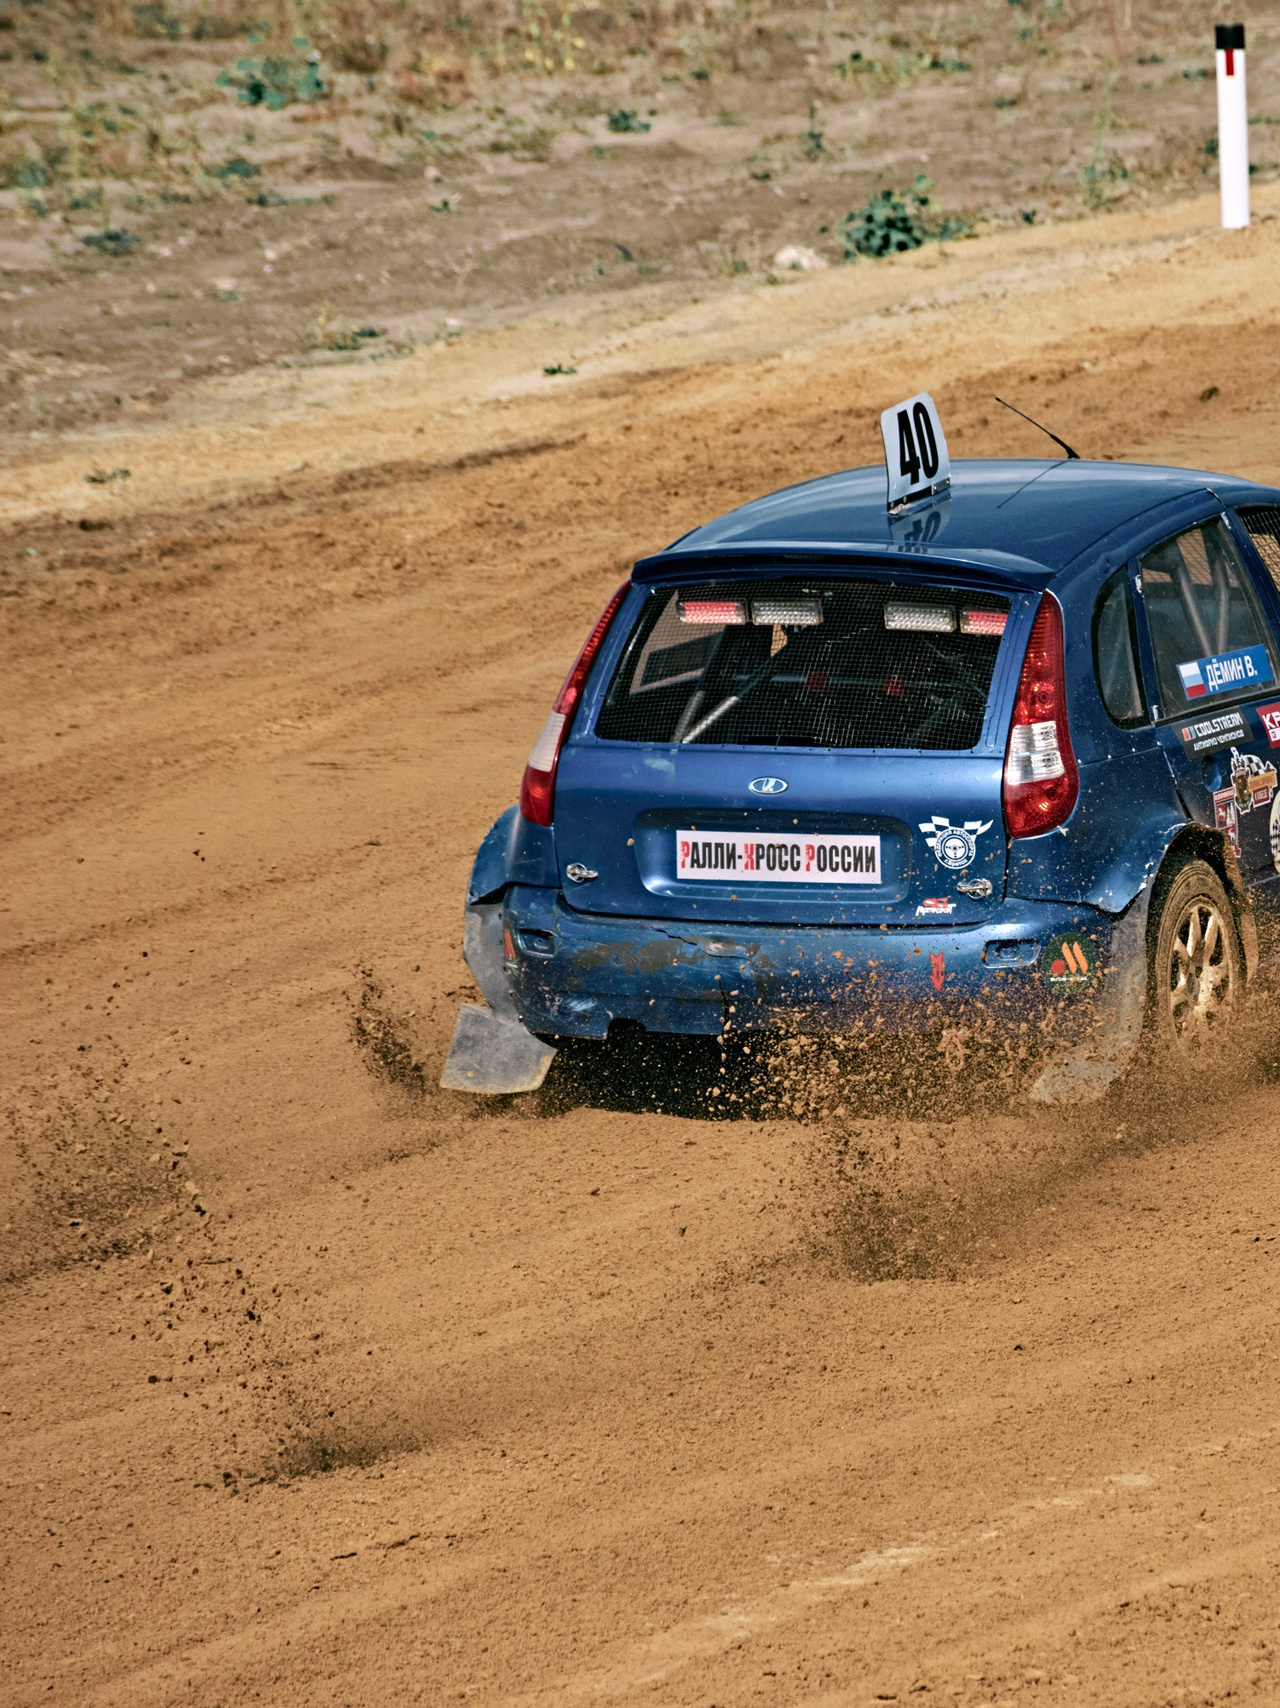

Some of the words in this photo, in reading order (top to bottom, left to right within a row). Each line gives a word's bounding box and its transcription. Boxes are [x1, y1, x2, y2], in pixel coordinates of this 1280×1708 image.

[897, 402, 939, 485] 40
[1205, 658, 1246, 692] ДЁМИН
[1245, 655, 1258, 678] В.
[1194, 712, 1243, 737] COOLSTREAM
[680, 840, 801, 872] РАЛЛИ-КРОСС
[805, 843, 876, 873] РОССИИ
